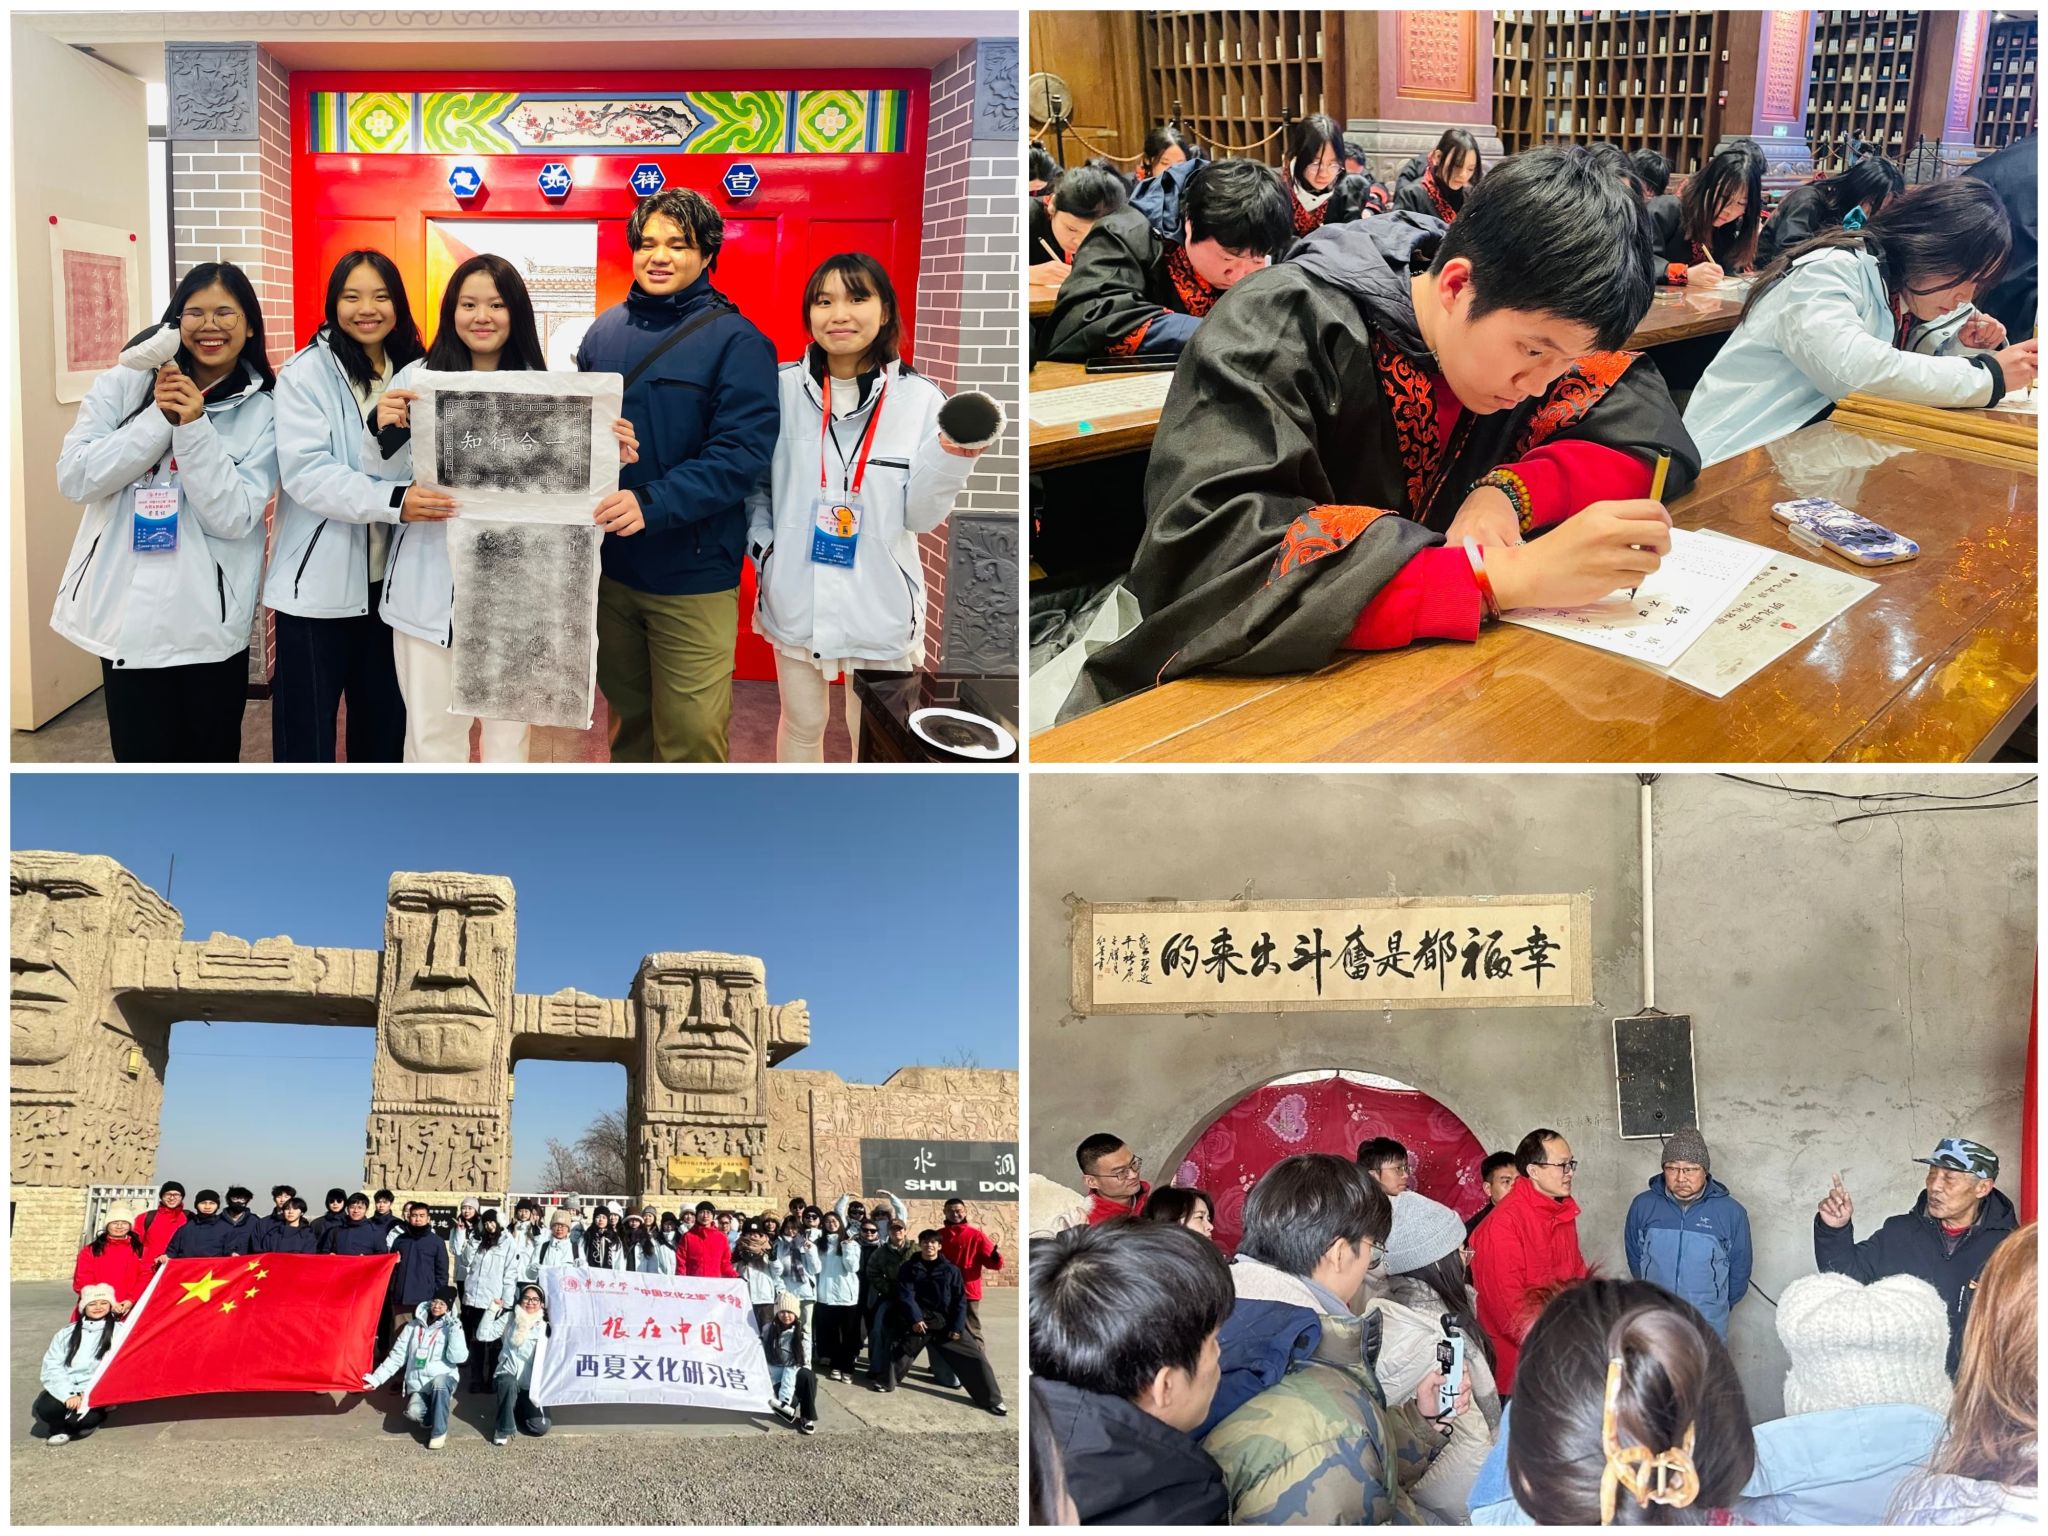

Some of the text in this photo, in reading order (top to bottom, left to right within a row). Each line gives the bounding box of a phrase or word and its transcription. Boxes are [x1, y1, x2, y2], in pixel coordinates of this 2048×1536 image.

[460, 430, 566, 452] 知行合一
[904, 1179, 958, 1192] SHUI
[602, 1316, 724, 1352] 根在中国
[576, 1353, 749, 1391] 西夏文化研习营
